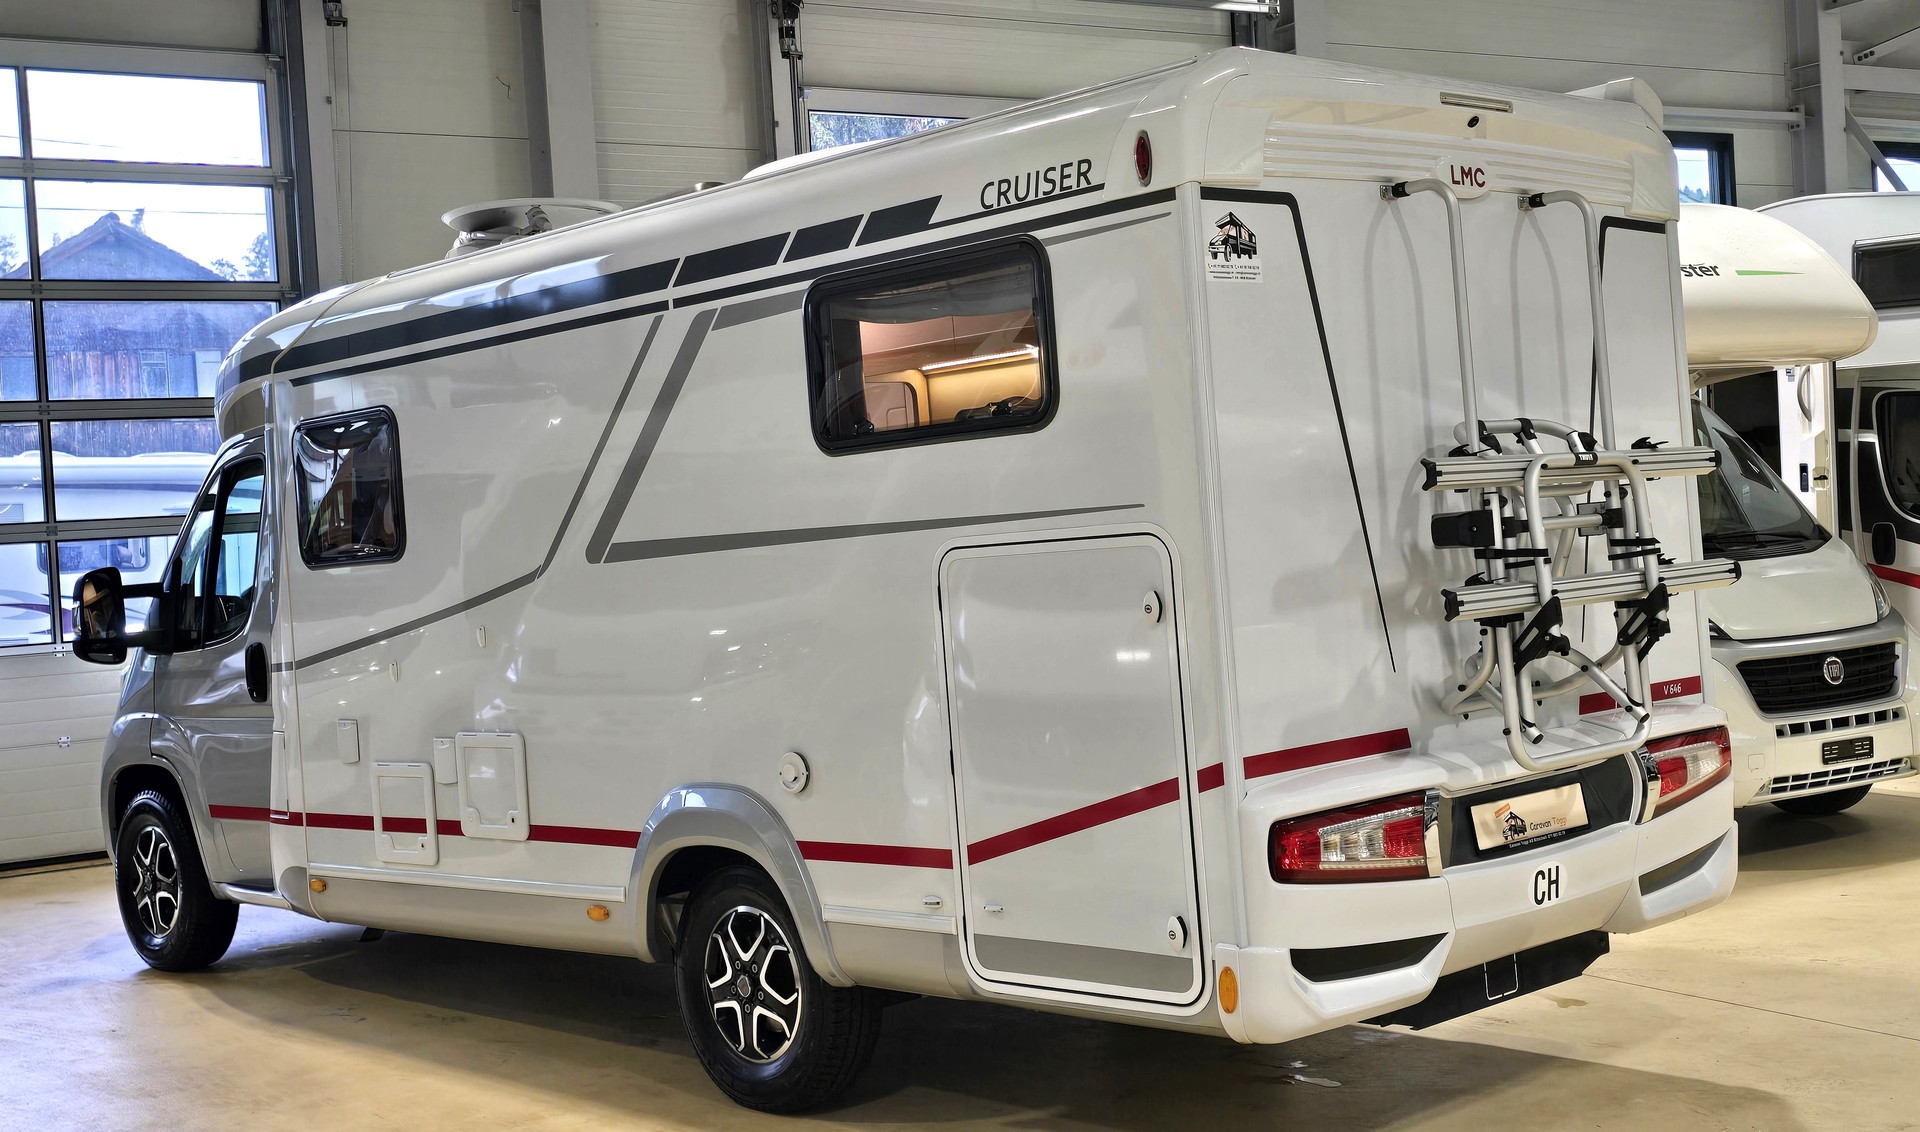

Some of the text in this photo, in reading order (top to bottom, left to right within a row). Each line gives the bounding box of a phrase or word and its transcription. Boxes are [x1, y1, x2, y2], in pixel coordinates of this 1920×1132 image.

[980, 158, 1092, 210] CRUISER
[1450, 164, 1486, 188] LMC
[1828, 664, 1840, 678] FIAT
[1663, 682, 1682, 695] V 646
[1533, 865, 1560, 906] CH
